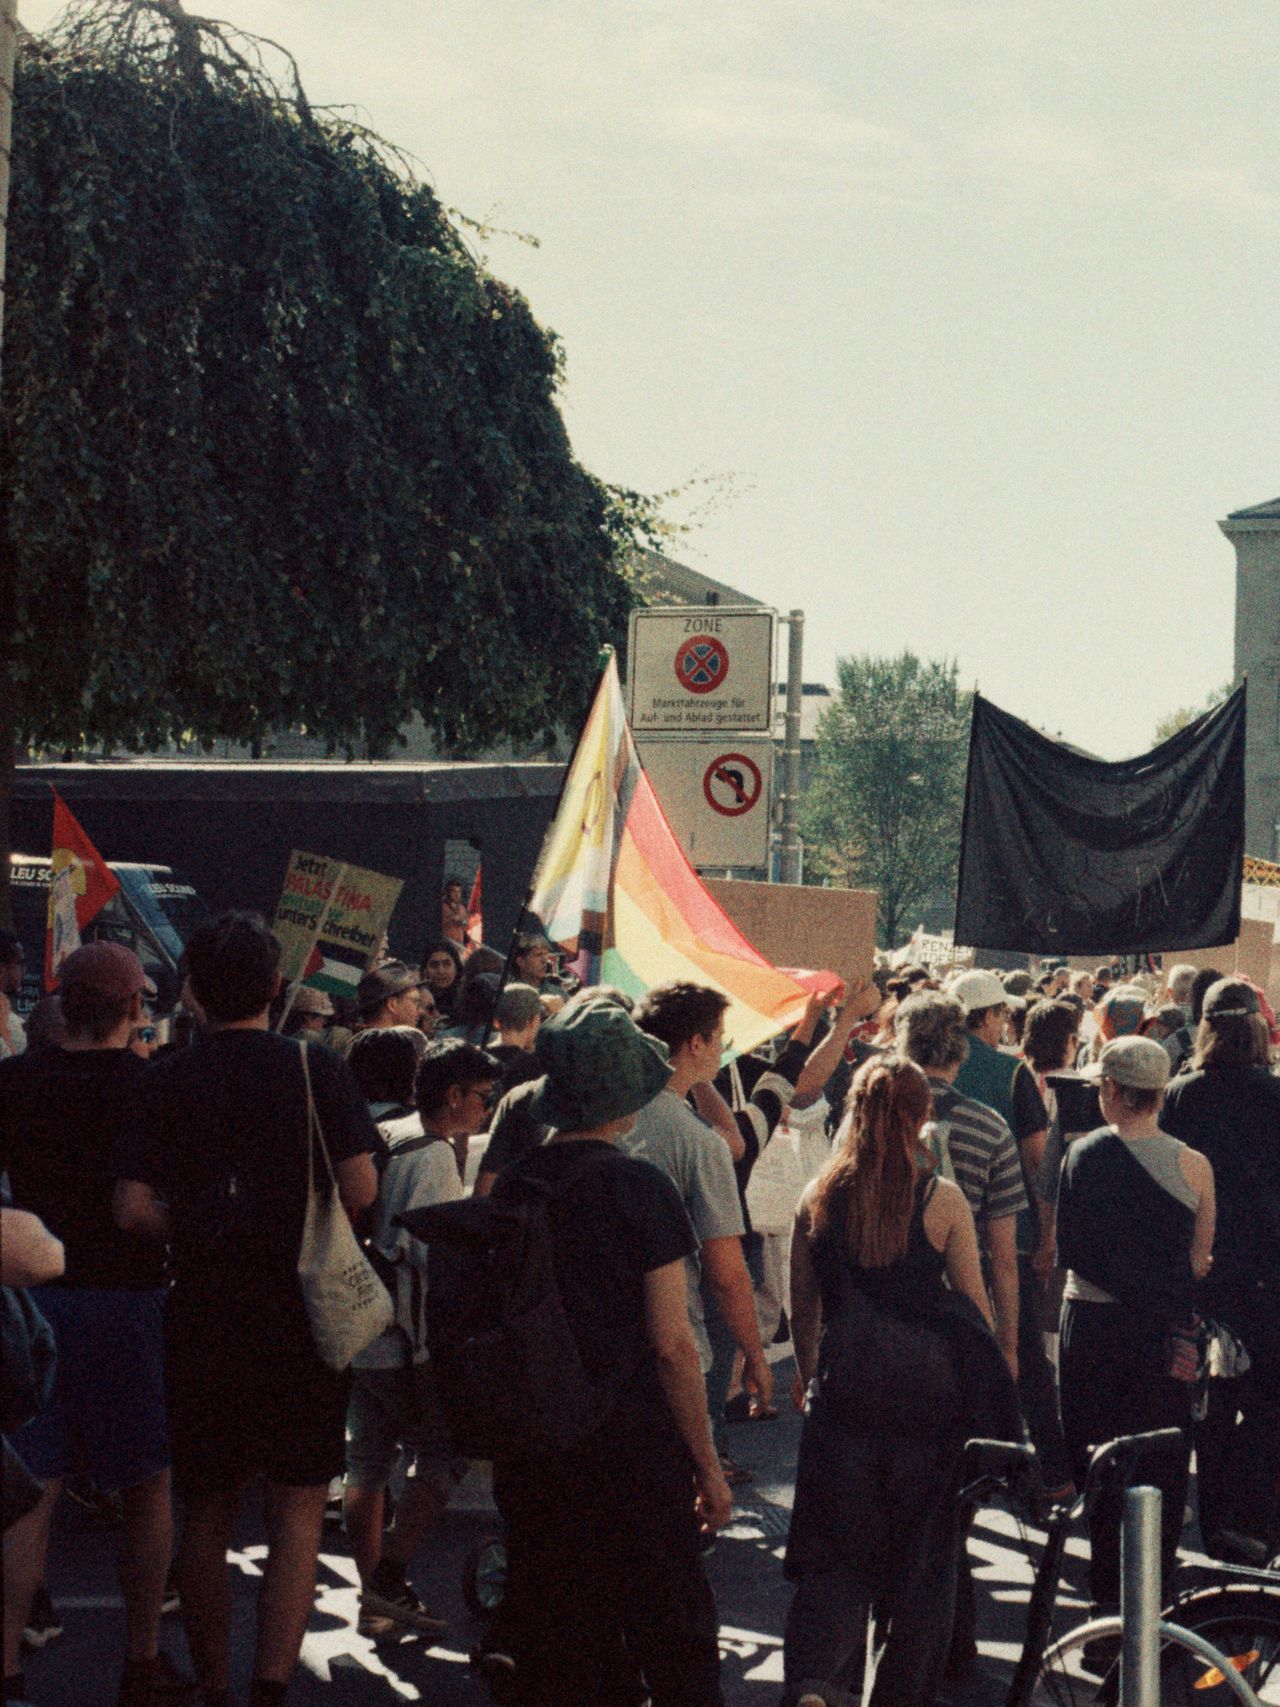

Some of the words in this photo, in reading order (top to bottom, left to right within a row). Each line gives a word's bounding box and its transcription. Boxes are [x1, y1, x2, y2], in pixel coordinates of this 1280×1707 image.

[684, 618, 722, 632] ZONE
[652, 698, 727, 710] Marktfahrzeuge
[732, 698, 745, 708] für
[640, 713, 660, 722] Auf-
[663, 713, 682, 722] und
[685, 713, 713, 722] Ablad
[717, 713, 761, 725] gestattet
[10, 867, 36, 880] LEU
